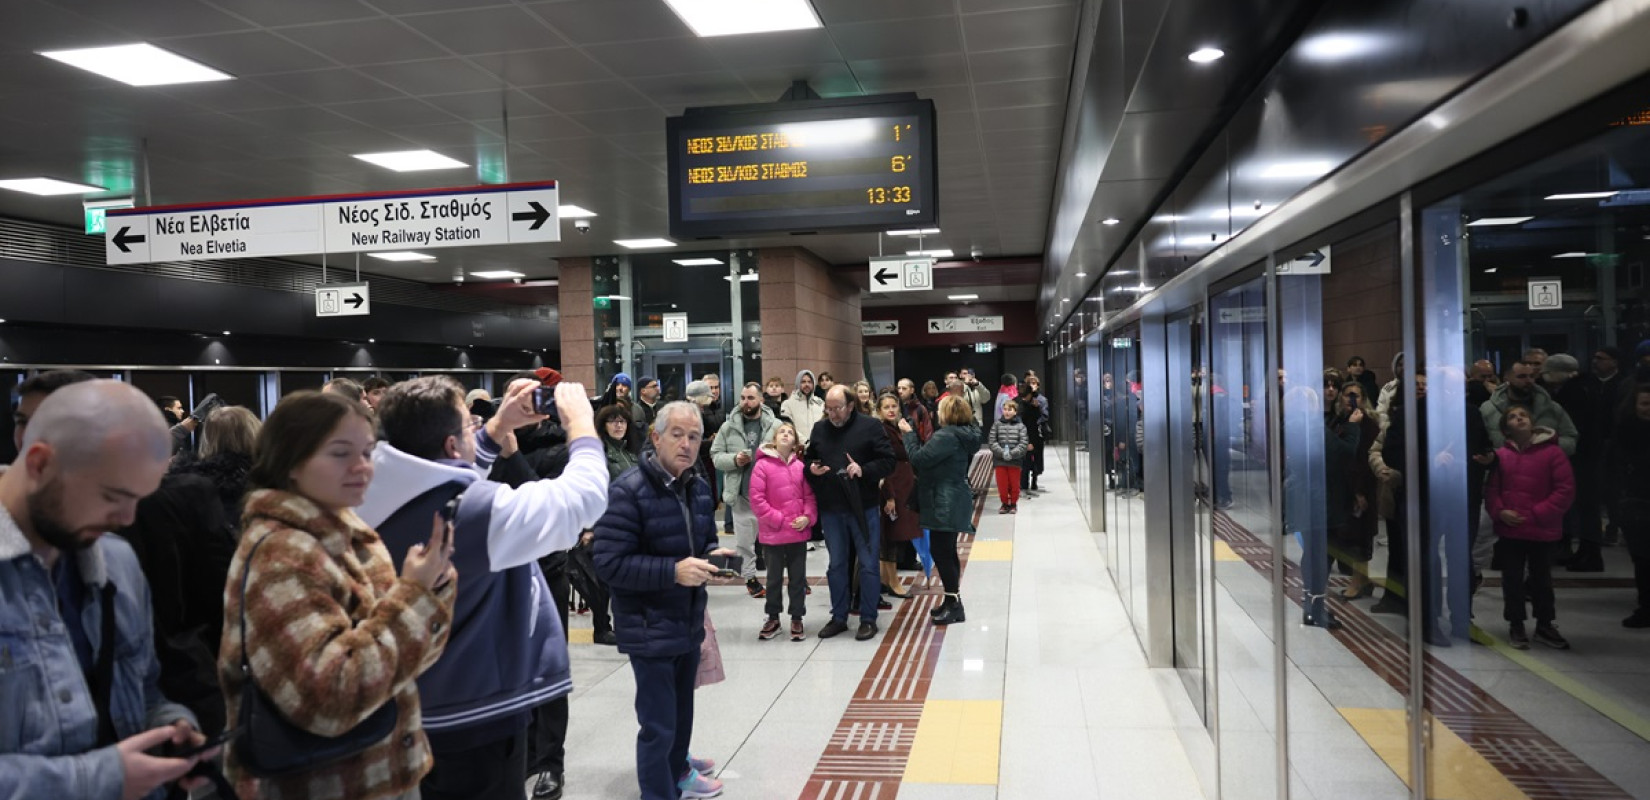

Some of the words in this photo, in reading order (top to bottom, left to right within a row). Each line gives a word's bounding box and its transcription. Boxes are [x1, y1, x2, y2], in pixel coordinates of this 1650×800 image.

[687, 137, 713, 154] ΝΕΟΣ
[688, 167, 715, 184] ΝΕΟΣ
[761, 161, 807, 180] ΣΤΑΘΜΟΣ
[867, 186, 911, 204] 13:33
[338, 204, 379, 227] Νέος
[384, 202, 415, 222] Σιδ.
[420, 197, 492, 221] Σταθμός
[155, 216, 186, 236] Νέα
[190, 212, 251, 235] Ελβετία
[351, 231, 379, 246] New
[382, 229, 431, 246] Railway
[435, 226, 481, 242] Station
[180, 240, 203, 255] Nea
[207, 238, 247, 254] Elvetia
